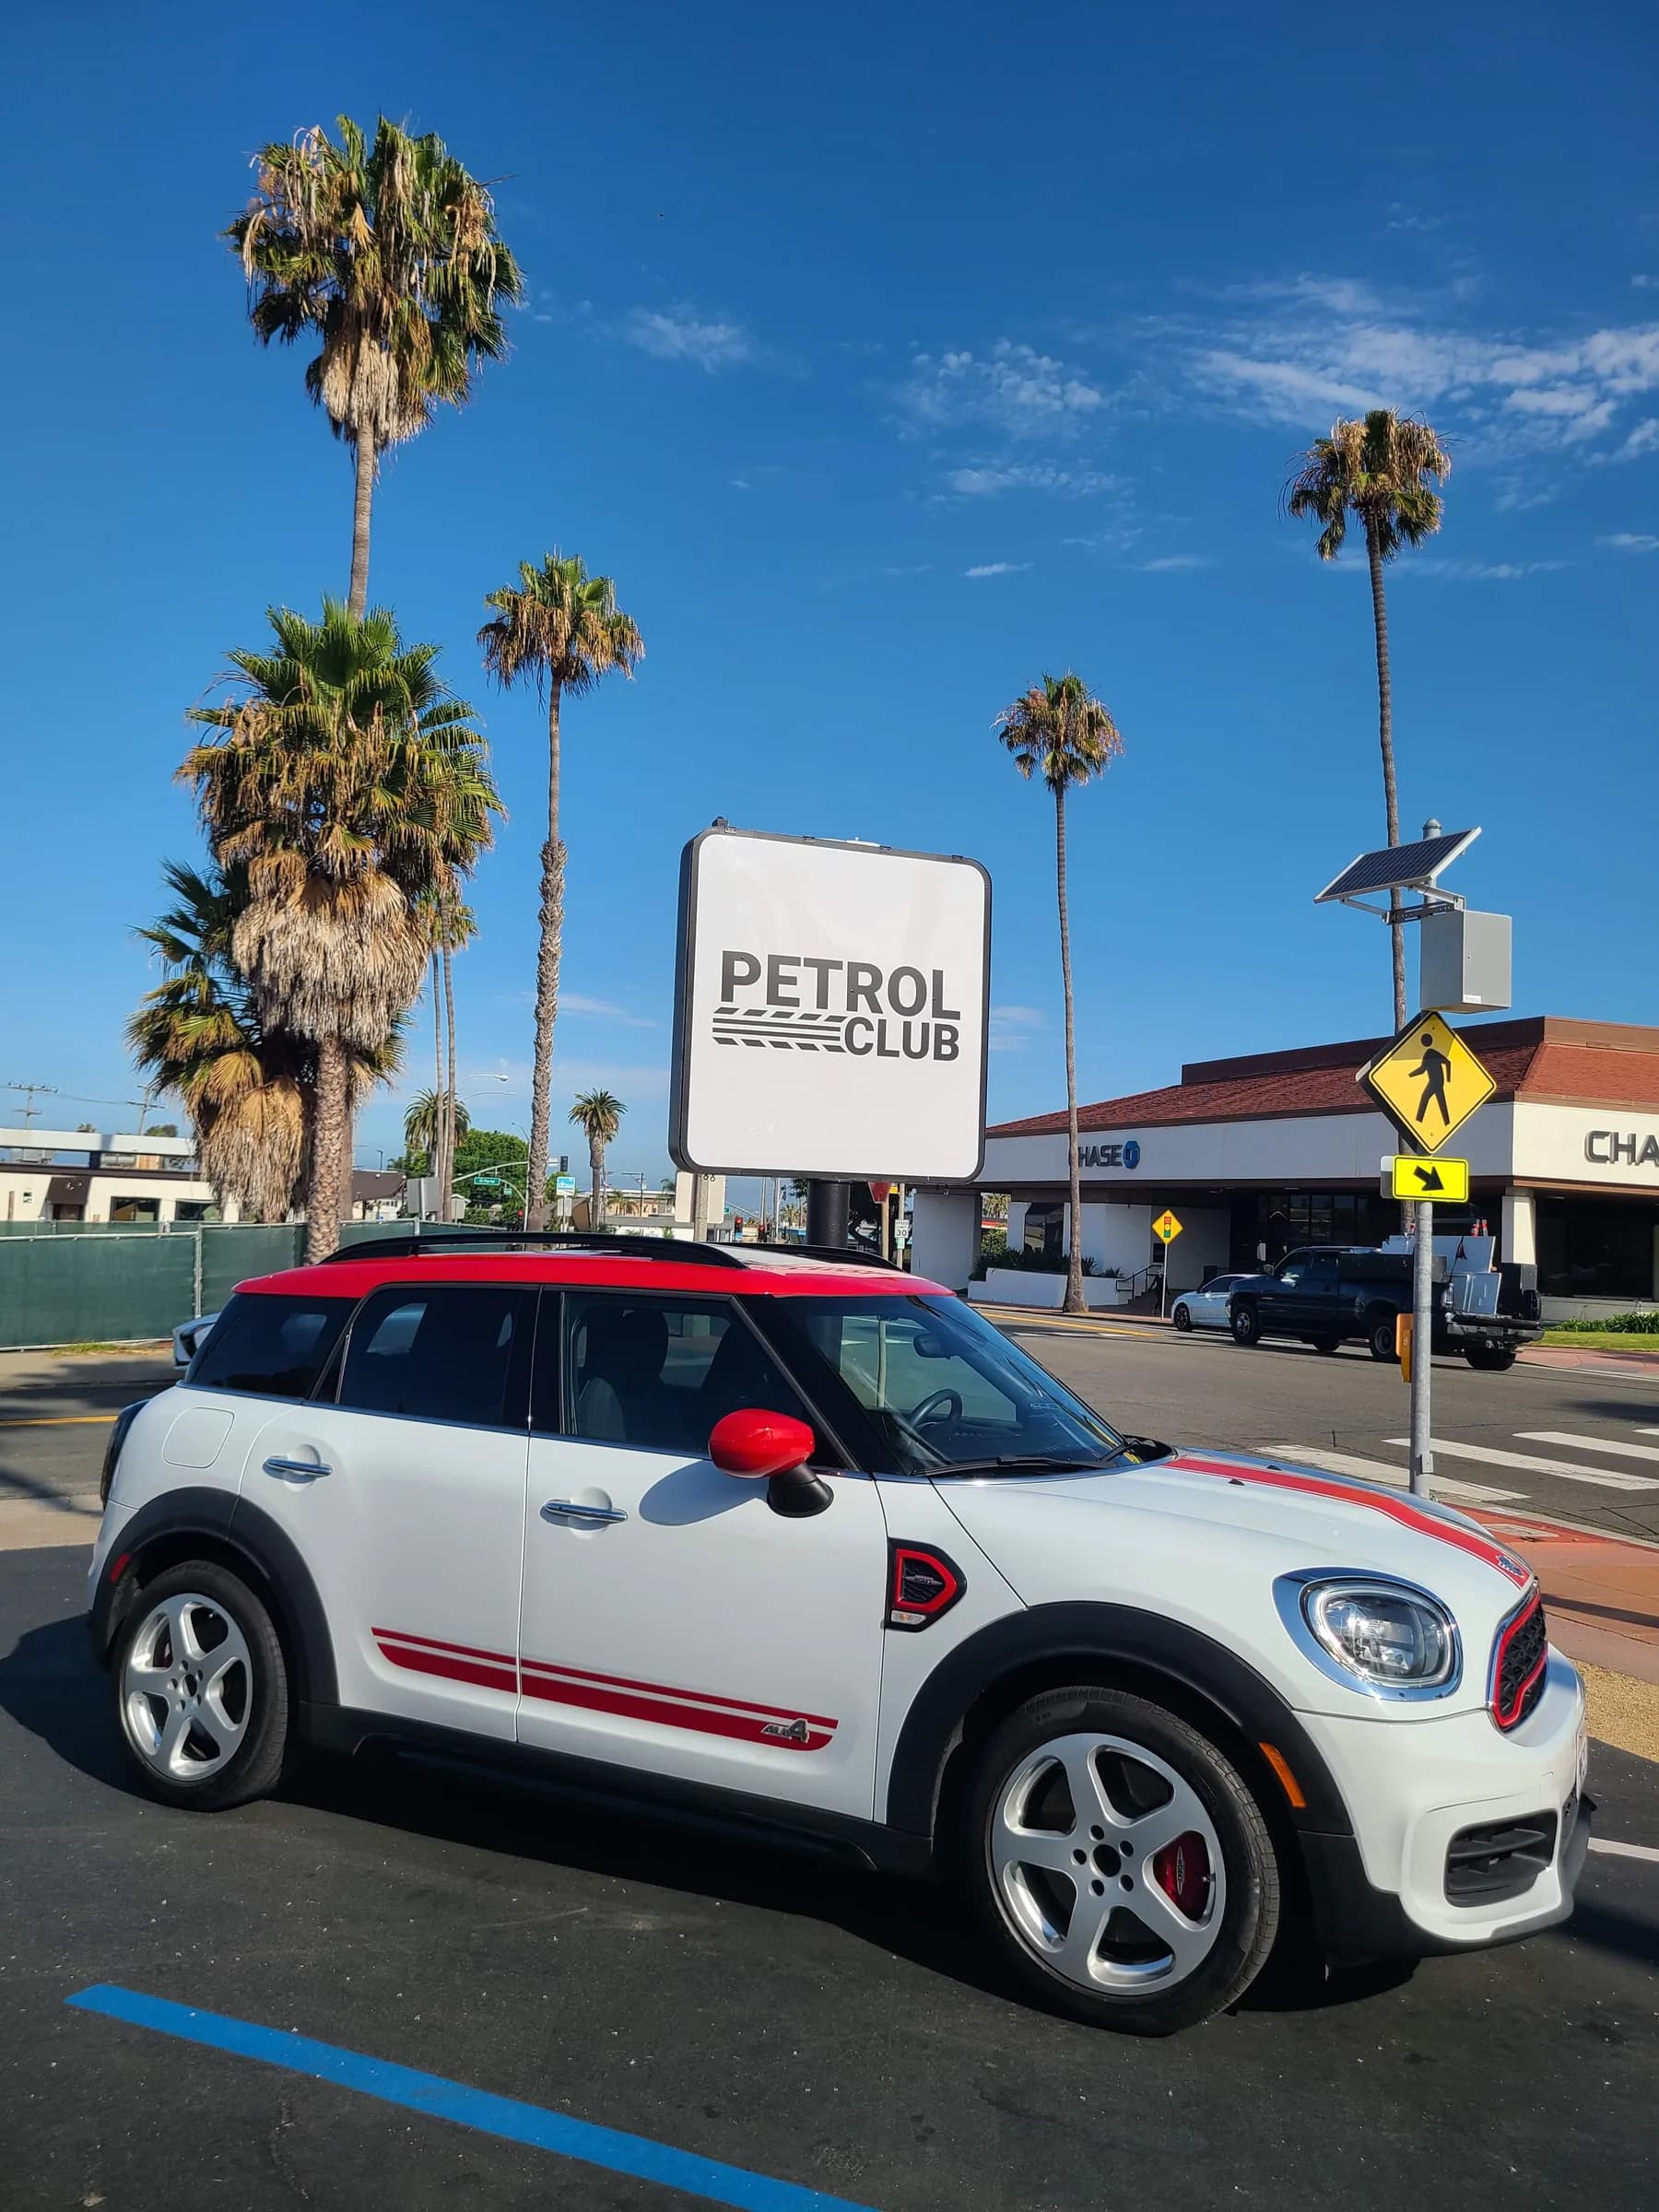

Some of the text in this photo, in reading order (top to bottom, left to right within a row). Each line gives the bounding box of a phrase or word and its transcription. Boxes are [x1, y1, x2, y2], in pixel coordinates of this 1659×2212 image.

[721, 950, 961, 1020] PETROL
[844, 1017, 960, 1061] CLUB
[1068, 1145, 1123, 1167] HASE
